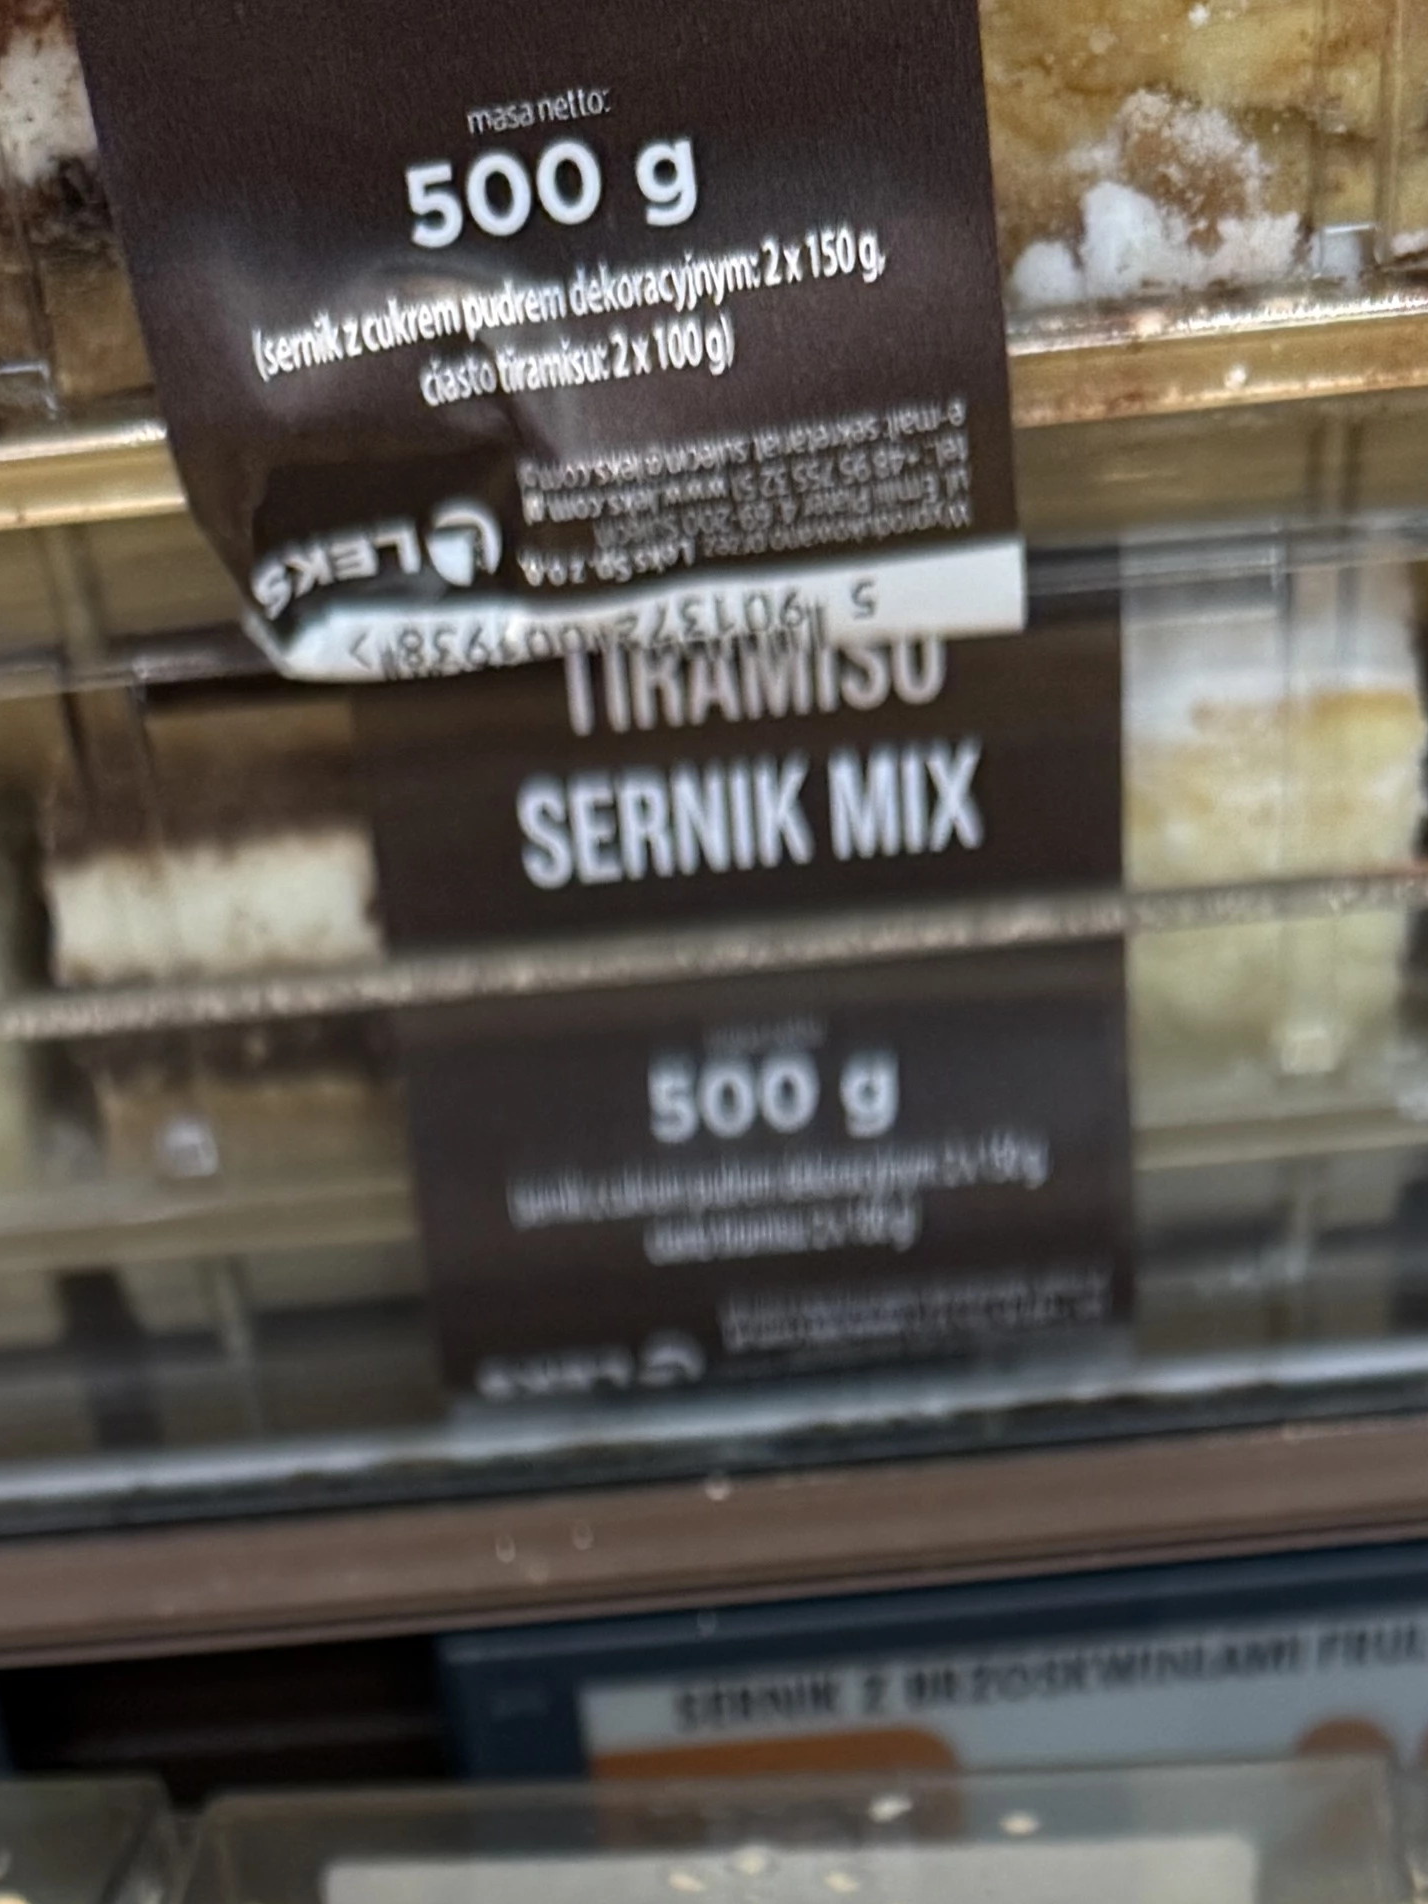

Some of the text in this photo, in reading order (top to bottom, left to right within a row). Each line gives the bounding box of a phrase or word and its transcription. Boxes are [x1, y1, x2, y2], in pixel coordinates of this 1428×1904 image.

[467, 88, 611, 134] masa netto:
[404, 135, 698, 248] 500 g
[252, 311, 343, 382] (sernik
[343, 320, 363, 358] z
[362, 297, 462, 353] cukrem
[462, 279, 568, 342] pudrem
[569, 252, 760, 317] dekoracyjnym:
[761, 237, 783, 287] 2
[783, 244, 804, 284] x
[805, 224, 856, 280] 150
[420, 355, 497, 407] ciasto
[497, 336, 610, 395] tiramisu:
[610, 330, 631, 380] 2
[631, 335, 653, 376] x
[653, 316, 704, 371] 100
[251, 516, 421, 621] LEKS
[516, 738, 985, 891] SERNIK MIX
[647, 1048, 901, 1145] 500 g
